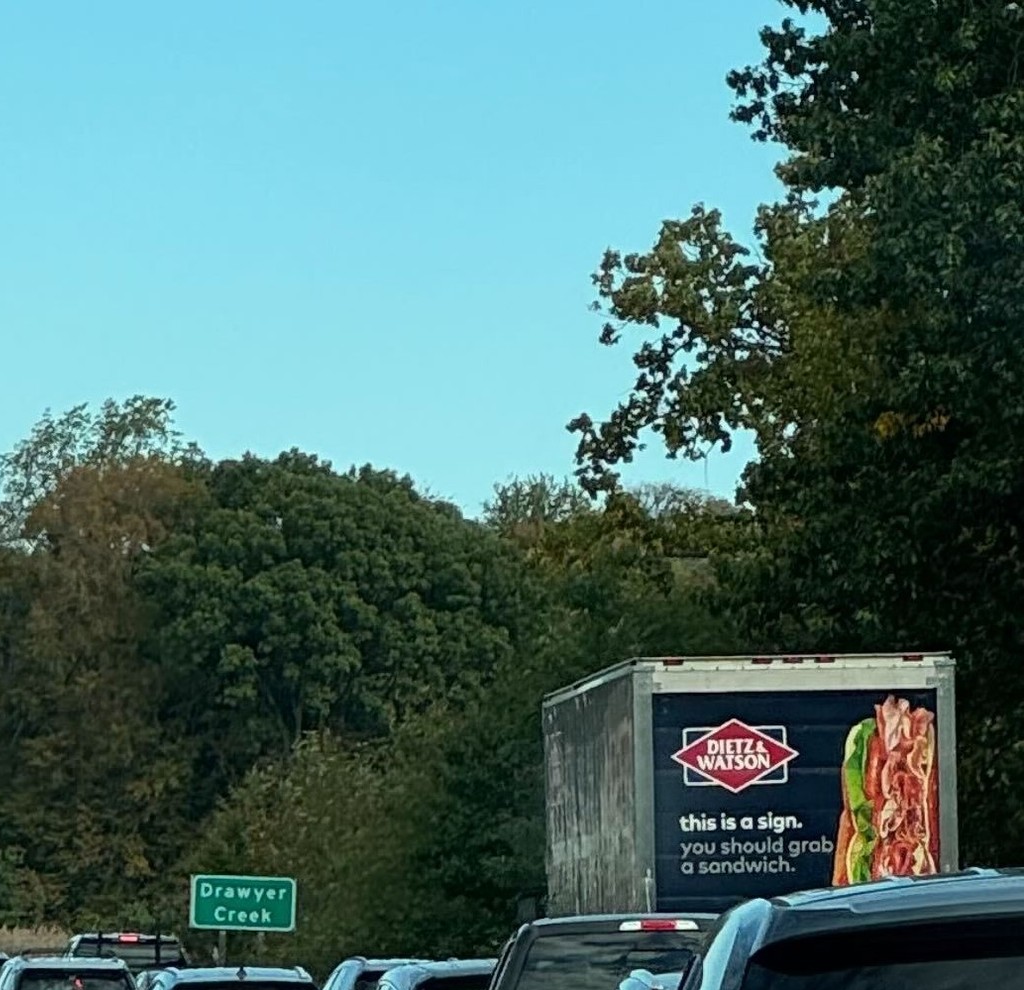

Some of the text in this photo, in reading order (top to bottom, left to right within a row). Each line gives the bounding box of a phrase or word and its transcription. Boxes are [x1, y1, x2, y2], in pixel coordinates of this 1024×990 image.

[707, 738, 755, 754] DIETZ
[696, 753, 770, 771] WATSON
[679, 811, 803, 834] this is a sign.
[680, 835, 834, 860] you should grab
[681, 855, 796, 874] a sandwich.
[200, 882, 287, 903] Drawyer
[214, 906, 272, 923] Creek
